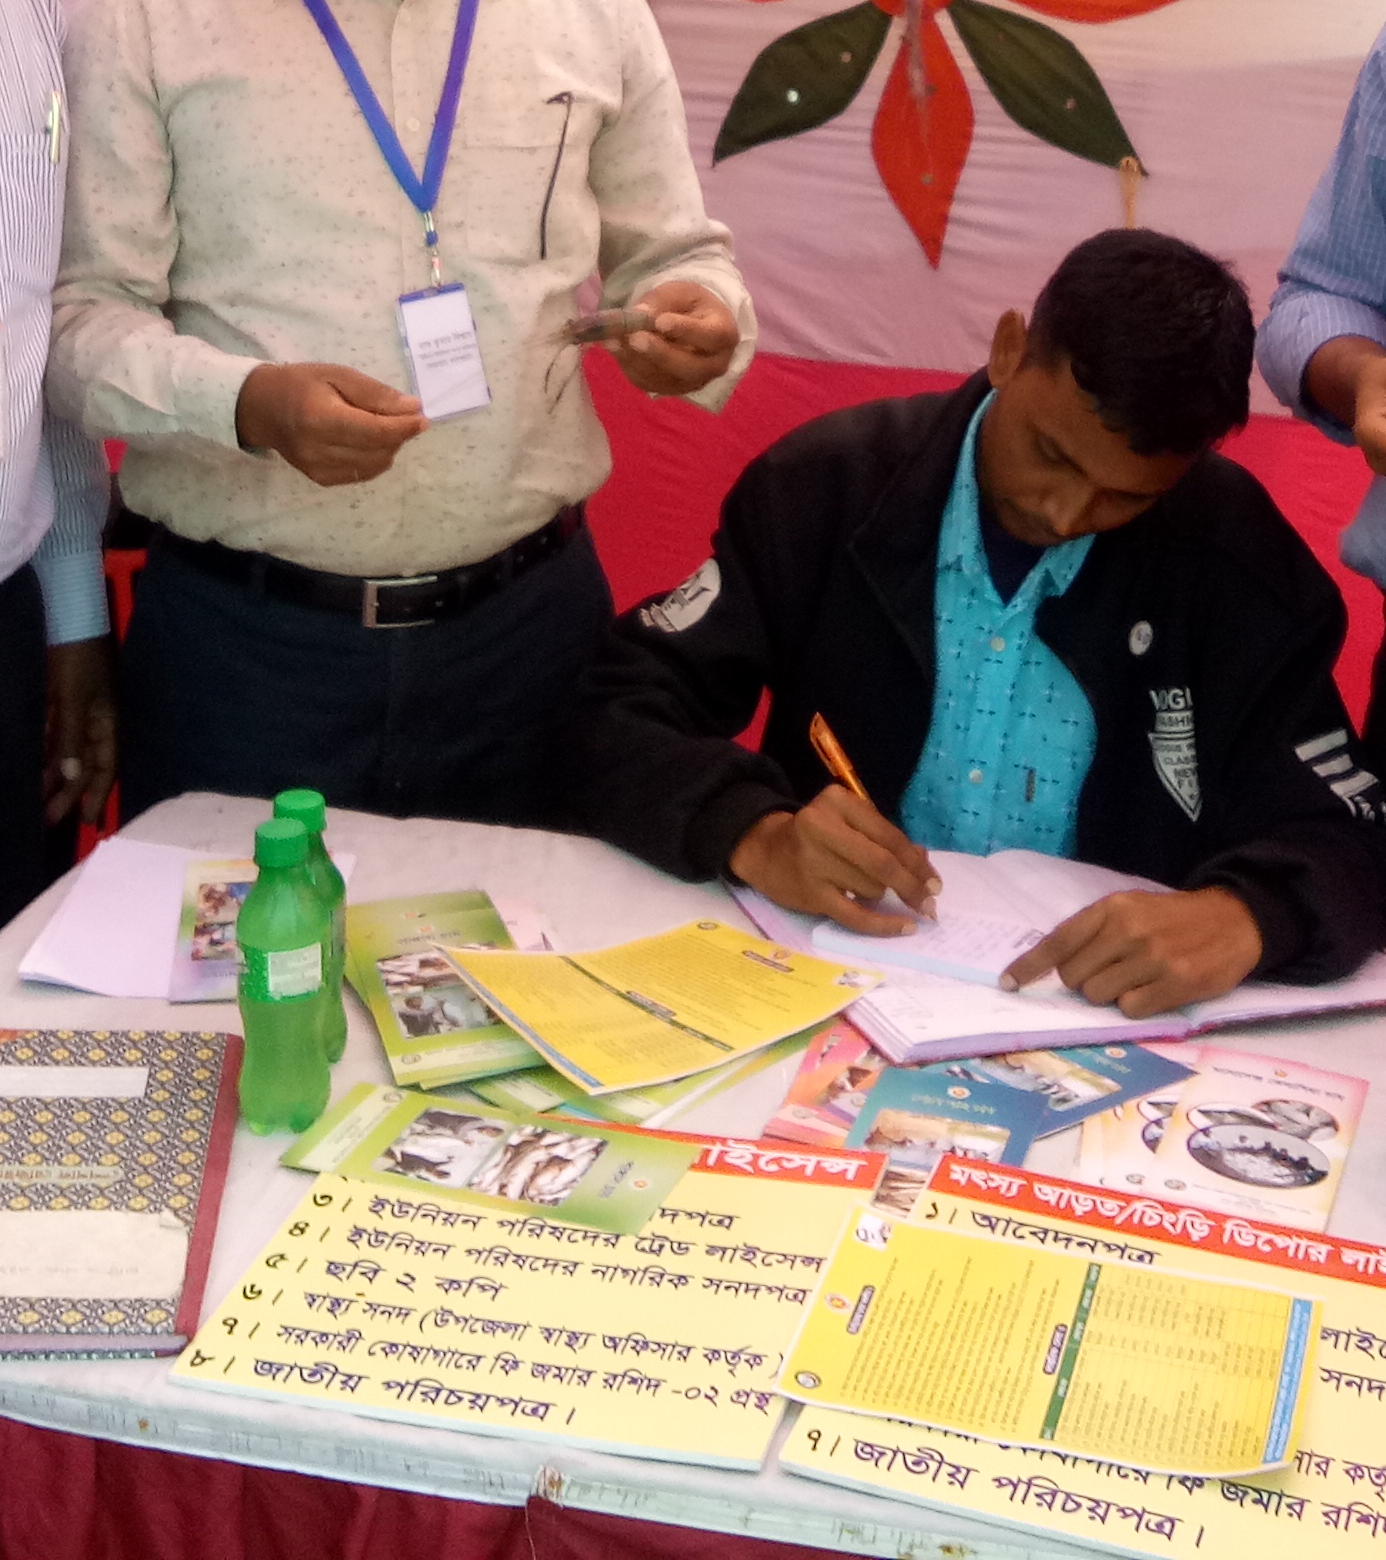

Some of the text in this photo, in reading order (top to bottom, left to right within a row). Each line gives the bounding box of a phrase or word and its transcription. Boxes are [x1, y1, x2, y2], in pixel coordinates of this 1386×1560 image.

[696, 1139, 868, 1181] াইসেন্স
[368, 1194, 488, 1230] ইউনিয়ন
[496, 1216, 625, 1249] পরিষদের
[634, 1231, 698, 1258] ট্রেড
[705, 1242, 828, 1274] লাইসেন্স
[948, 1163, 1028, 1198] মৎস্য
[1222, 1220, 1335, 1265] ডিপোর
[971, 1210, 1162, 1265] আবেদনপত্র
[325, 1259, 386, 1284] ছবি
[395, 1271, 417, 1292] ২
[435, 1275, 509, 1302] কপি
[347, 1225, 457, 1259] ইউনিয়ন
[464, 1245, 584, 1277] পরিষদের
[591, 1262, 695, 1290] নাগরিক
[702, 1275, 813, 1306] সনদপত্র
[362, 1299, 418, 1325] সনদ
[602, 1332, 697, 1363] অফিসার
[253, 1357, 371, 1393] জাতীয়
[276, 1323, 365, 1354] সরকারী
[367, 1340, 487, 1373] কোষাগারে
[530, 1360, 598, 1388] জমার
[602, 1368, 667, 1397] রশিদ
[853, 1436, 981, 1490] জাতীয়
[1217, 1476, 1312, 1522] জমার
